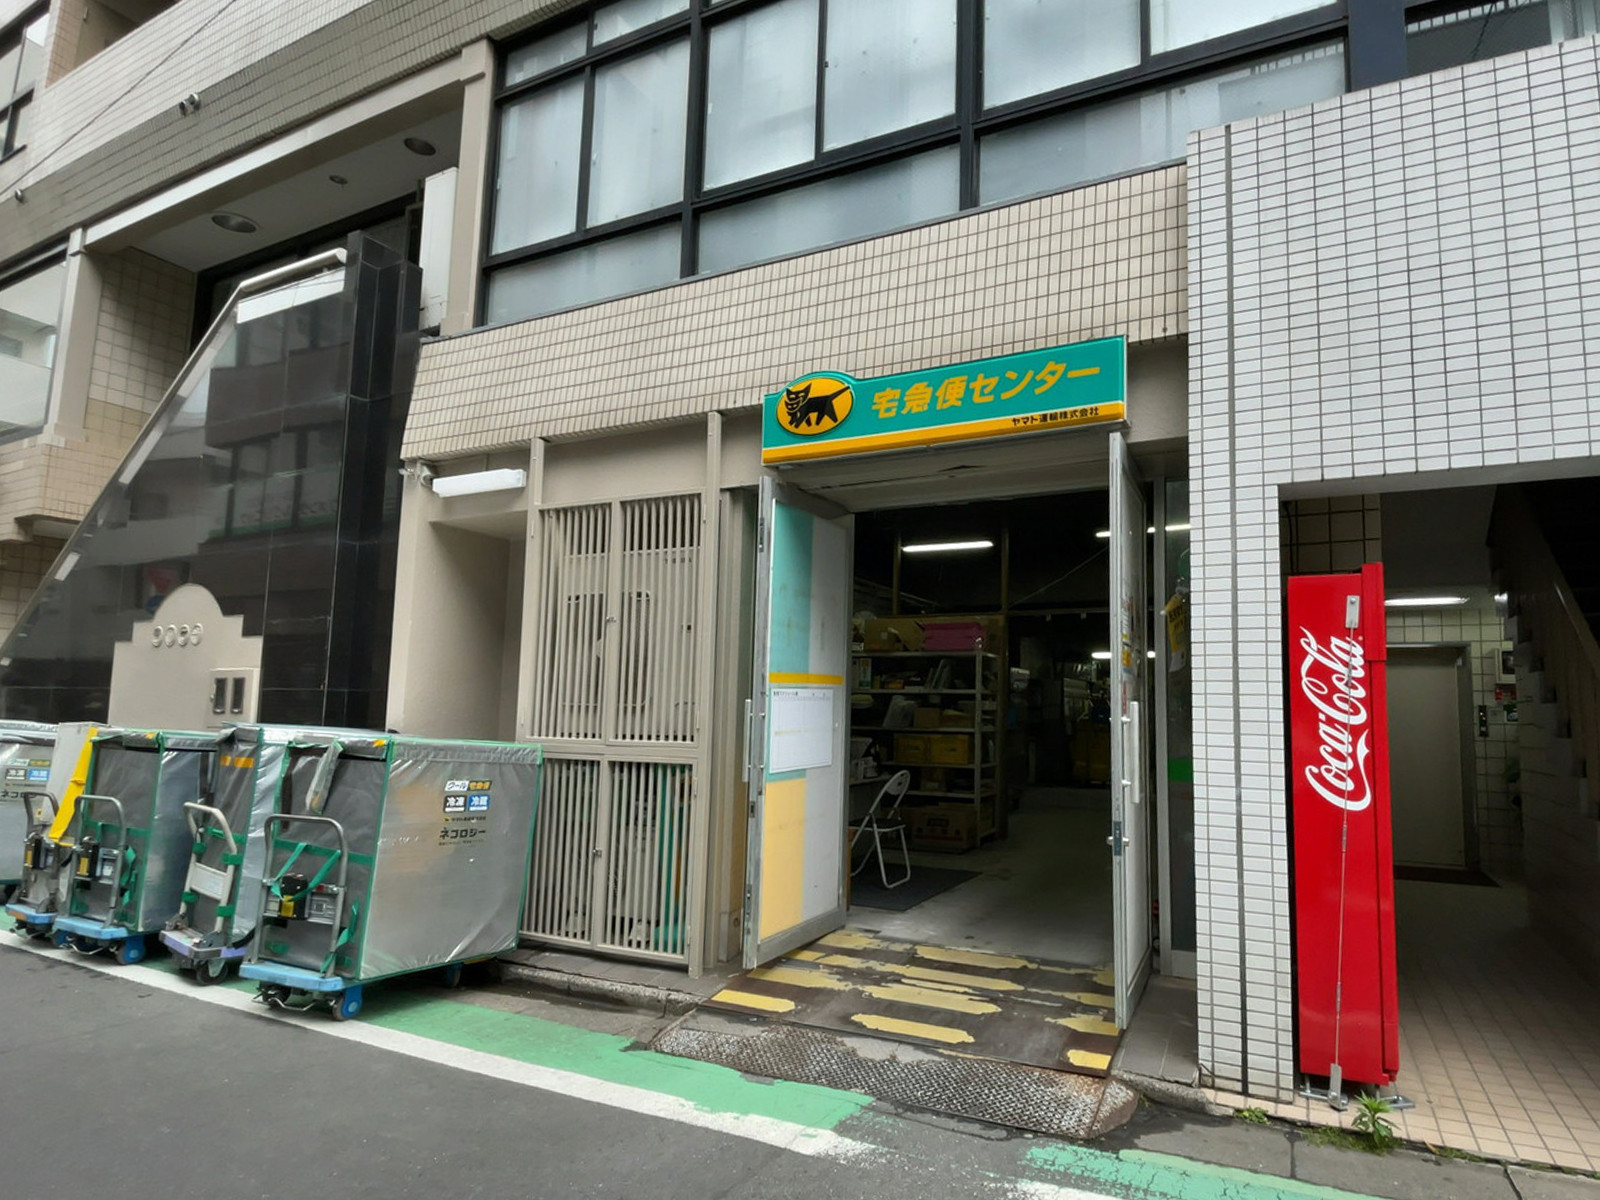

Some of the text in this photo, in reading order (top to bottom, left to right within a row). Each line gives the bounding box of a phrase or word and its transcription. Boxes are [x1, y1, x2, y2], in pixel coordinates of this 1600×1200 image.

[871, 360, 1101, 419] 宅急便センター
[1011, 406, 1100, 426] ヤマト運輸株式会社
[1299, 626, 1371, 811] Coca-Cola
[439, 826, 487, 840] ネコロジー
